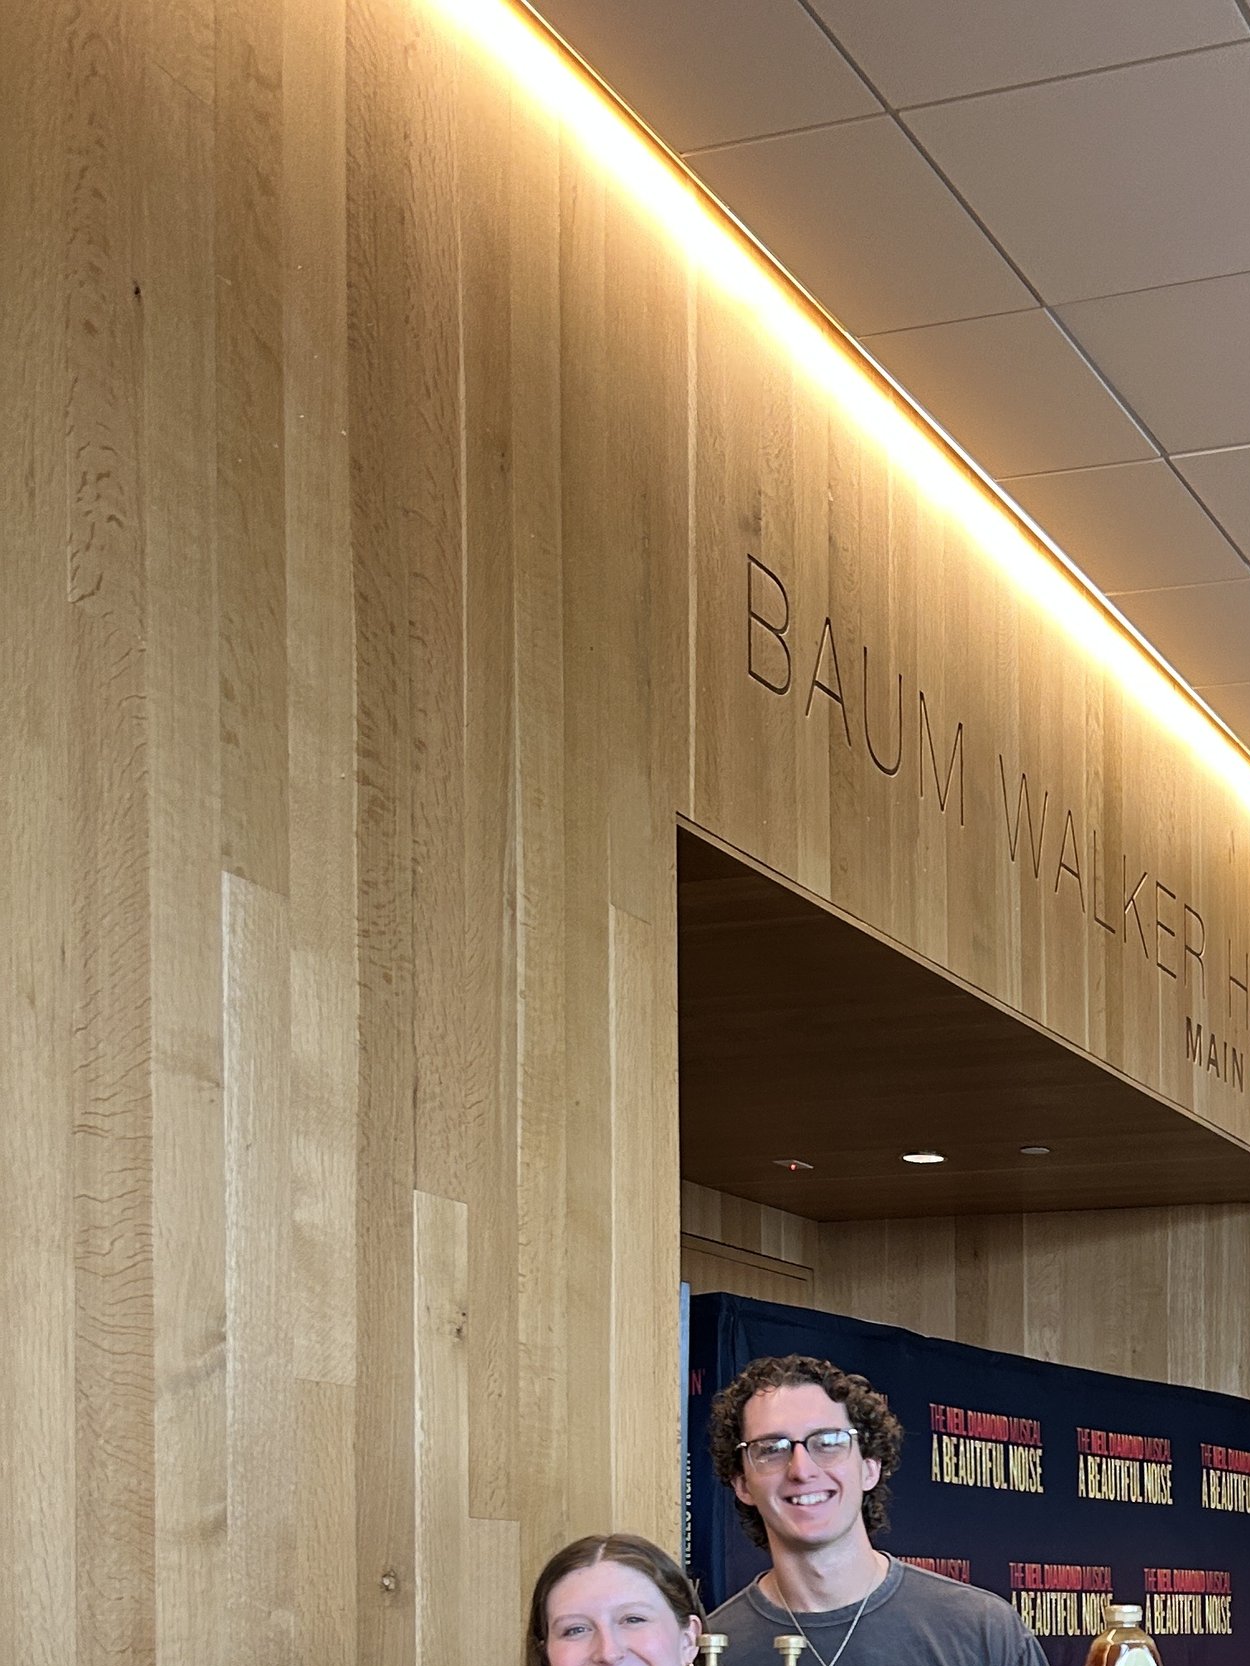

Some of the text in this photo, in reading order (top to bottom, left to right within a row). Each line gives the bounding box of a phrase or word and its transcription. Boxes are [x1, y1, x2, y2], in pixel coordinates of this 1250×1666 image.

[747, 554, 965, 828] BAUM
[999, 754, 1206, 999] WALKER
[1185, 1016, 1244, 1094] MAIN
[931, 1433, 1044, 1493] A BEAUTIFUL NOISE
[1078, 1454, 1173, 1505] A BEAUTIFUL NOISE
[1201, 1468, 1209, 1508] A
[1020, 1591, 1081, 1636] BEAUTIFUL
[1145, 1593, 1233, 1635] A BEAUTIFUL NOISE
